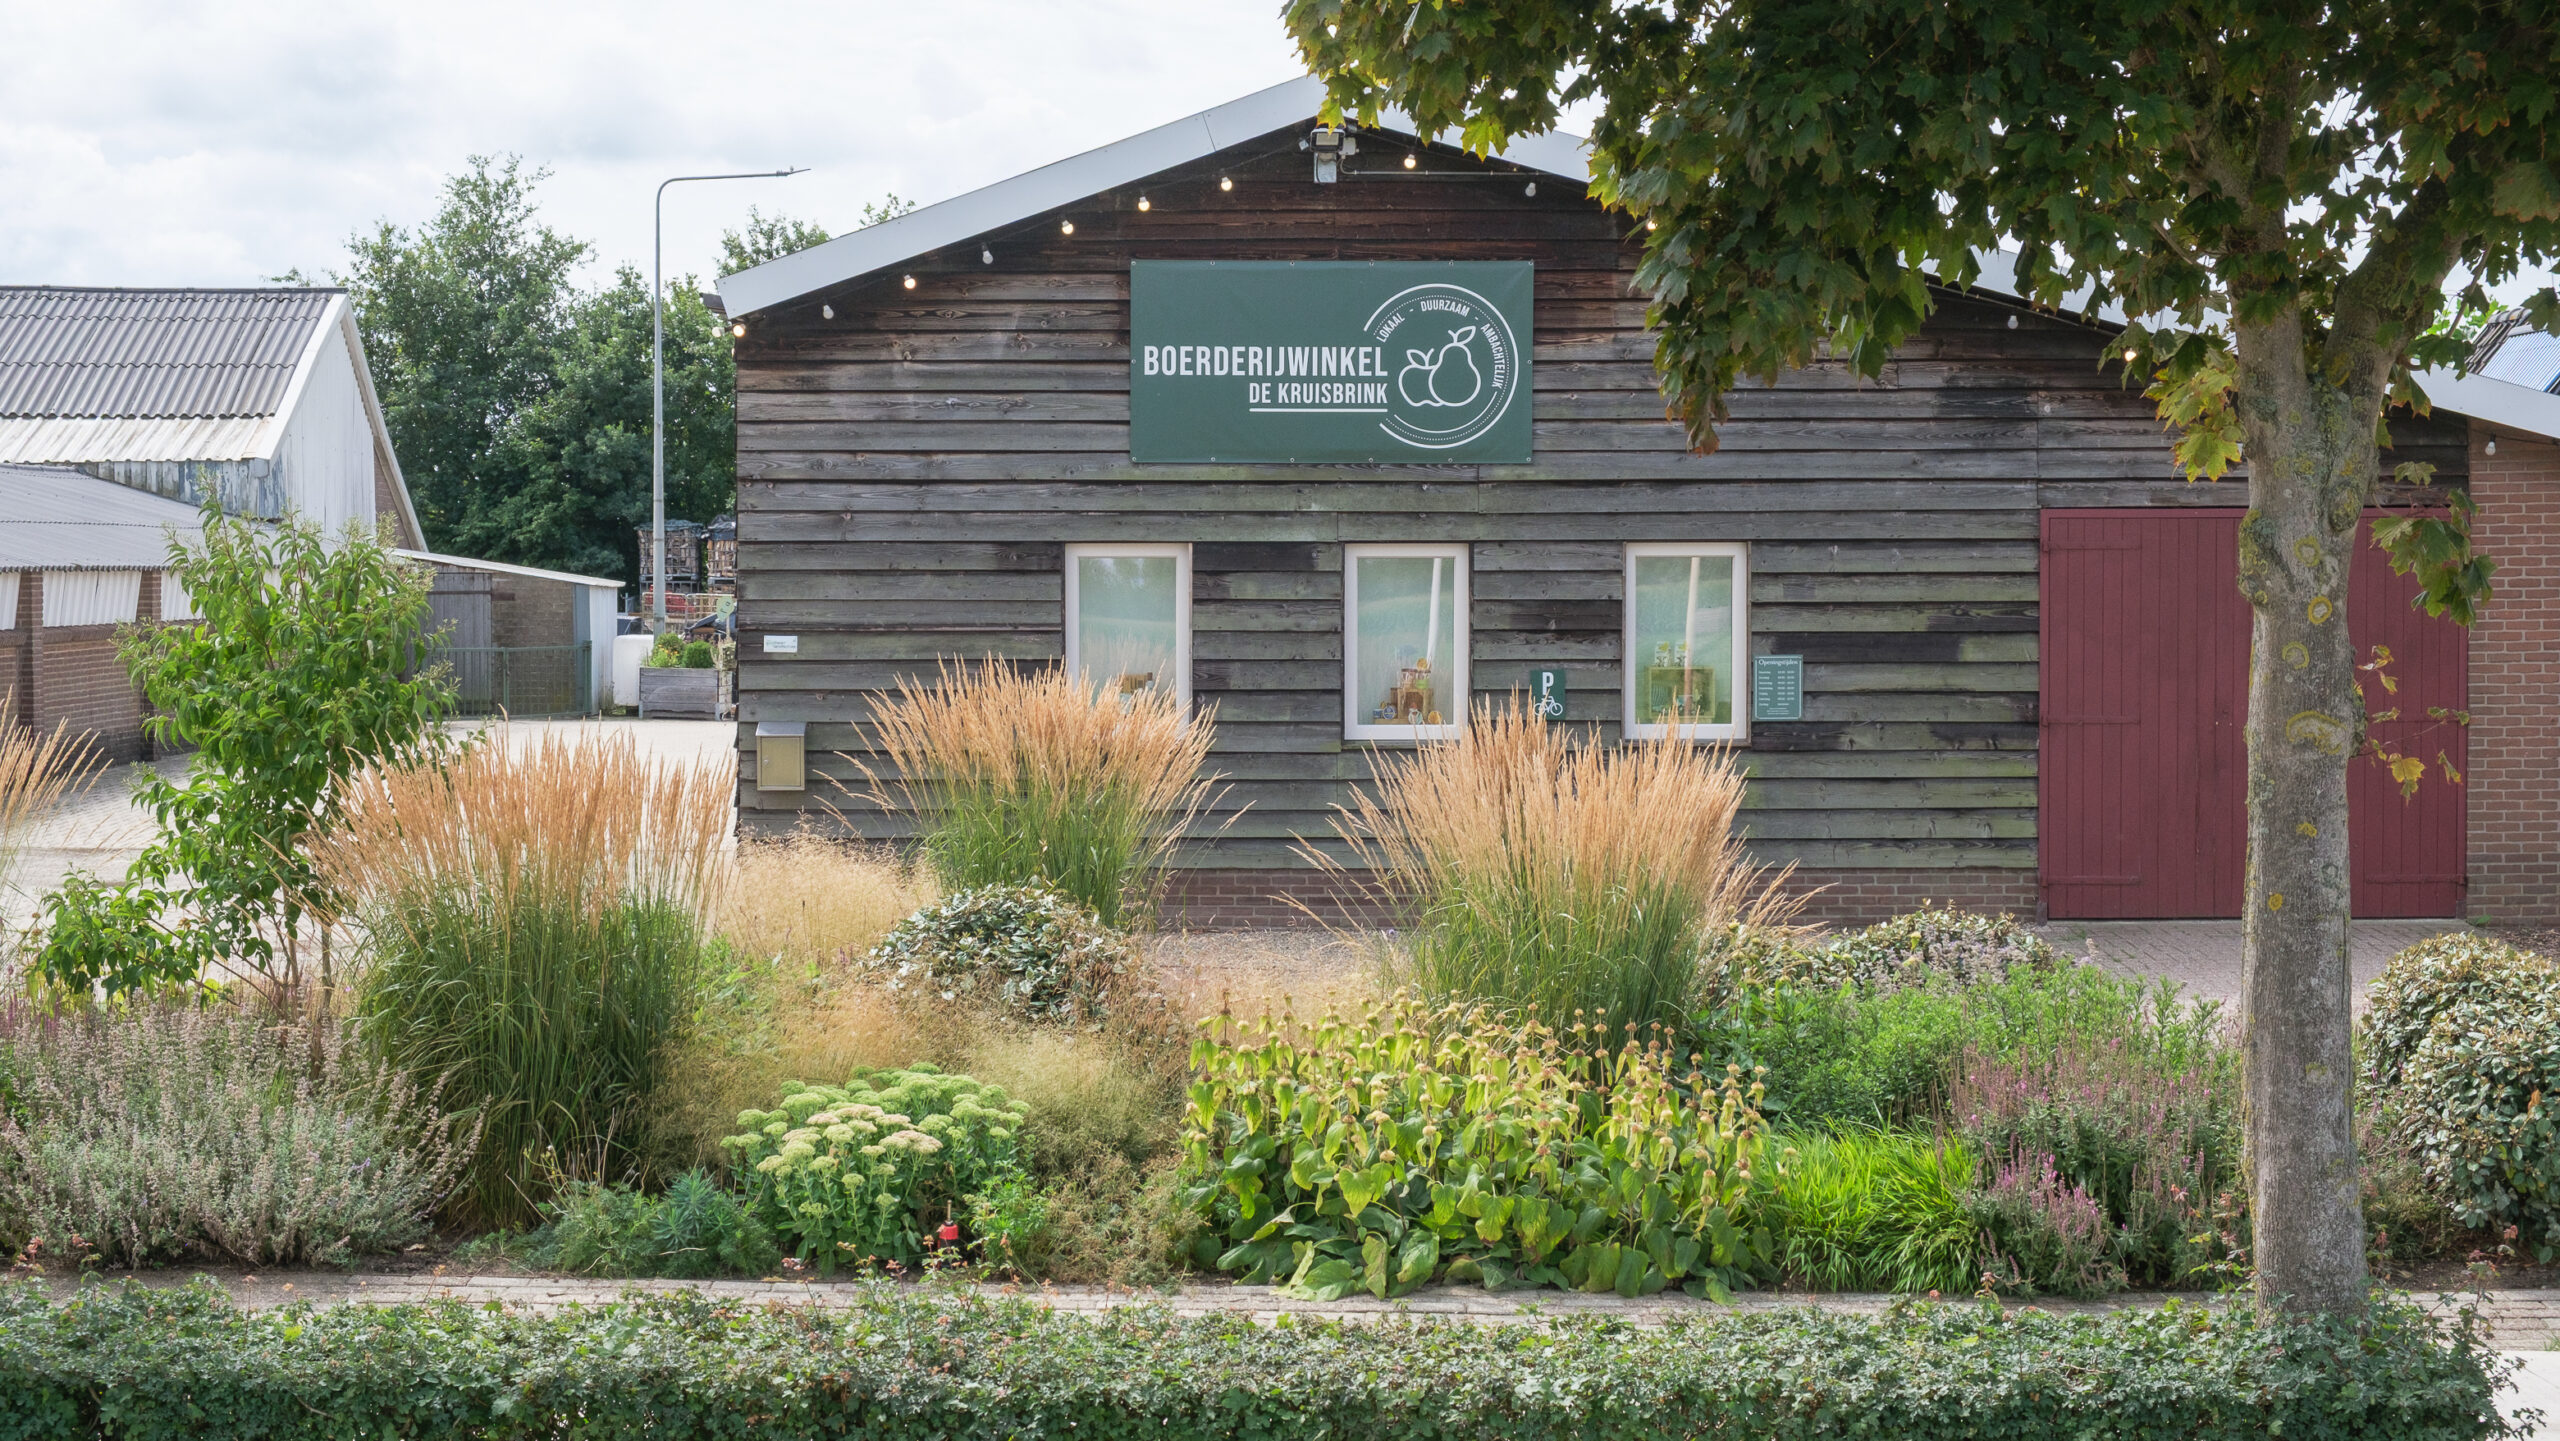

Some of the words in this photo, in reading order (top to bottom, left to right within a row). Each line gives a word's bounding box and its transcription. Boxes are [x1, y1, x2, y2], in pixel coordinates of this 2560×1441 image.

[1376, 313, 1405, 343] LOKAAL
[1420, 299, 1470, 317] DUURZAAM
[1480, 322, 1506, 389] AMBACHTELIJK
[1144, 346, 1388, 376] BOERDERIJWINKEL
[1250, 383, 1271, 403] DE
[1279, 383, 1387, 403] KRUISBRINK
[1542, 672, 1554, 695] P
